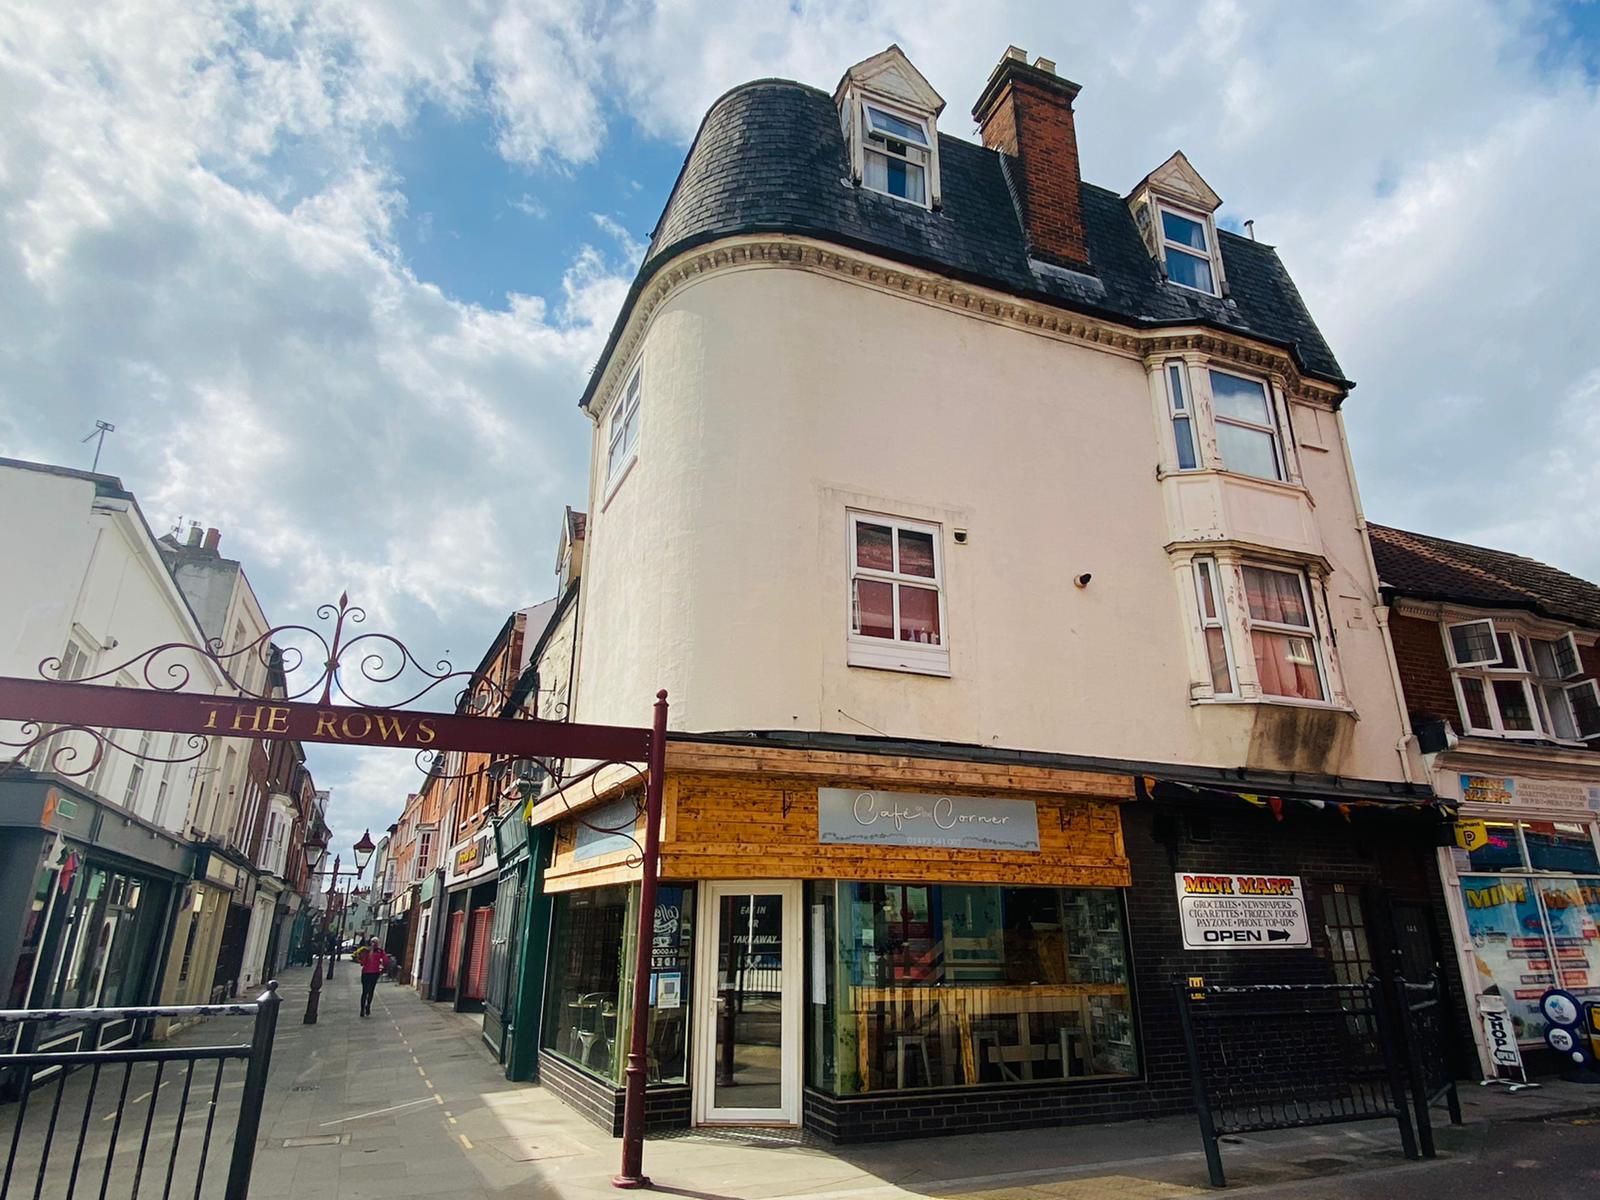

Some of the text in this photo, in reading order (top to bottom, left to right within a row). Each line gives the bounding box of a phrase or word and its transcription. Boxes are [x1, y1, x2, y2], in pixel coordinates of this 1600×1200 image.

[200, 700, 437, 744] THE ROWS
[1469, 776, 1505, 790] MINI
[1464, 788, 1512, 804] MART
[853, 792, 921, 832] Café
[933, 797, 1009, 830] Corner
[1183, 875, 1294, 896] MINI MART
[1465, 884, 1526, 909] MINI
[740, 905, 767, 915] EA IN
[1193, 900, 1293, 909] GROCERIES NEWSPAPERS
[1189, 909, 1299, 918] CIGARETTES FROZEN FOODS
[1196, 918, 1295, 928] PAYZONE PHONE TOP-UPS
[1203, 930, 1262, 942] OPEN
[1486, 1011, 1508, 1048] SHOP
